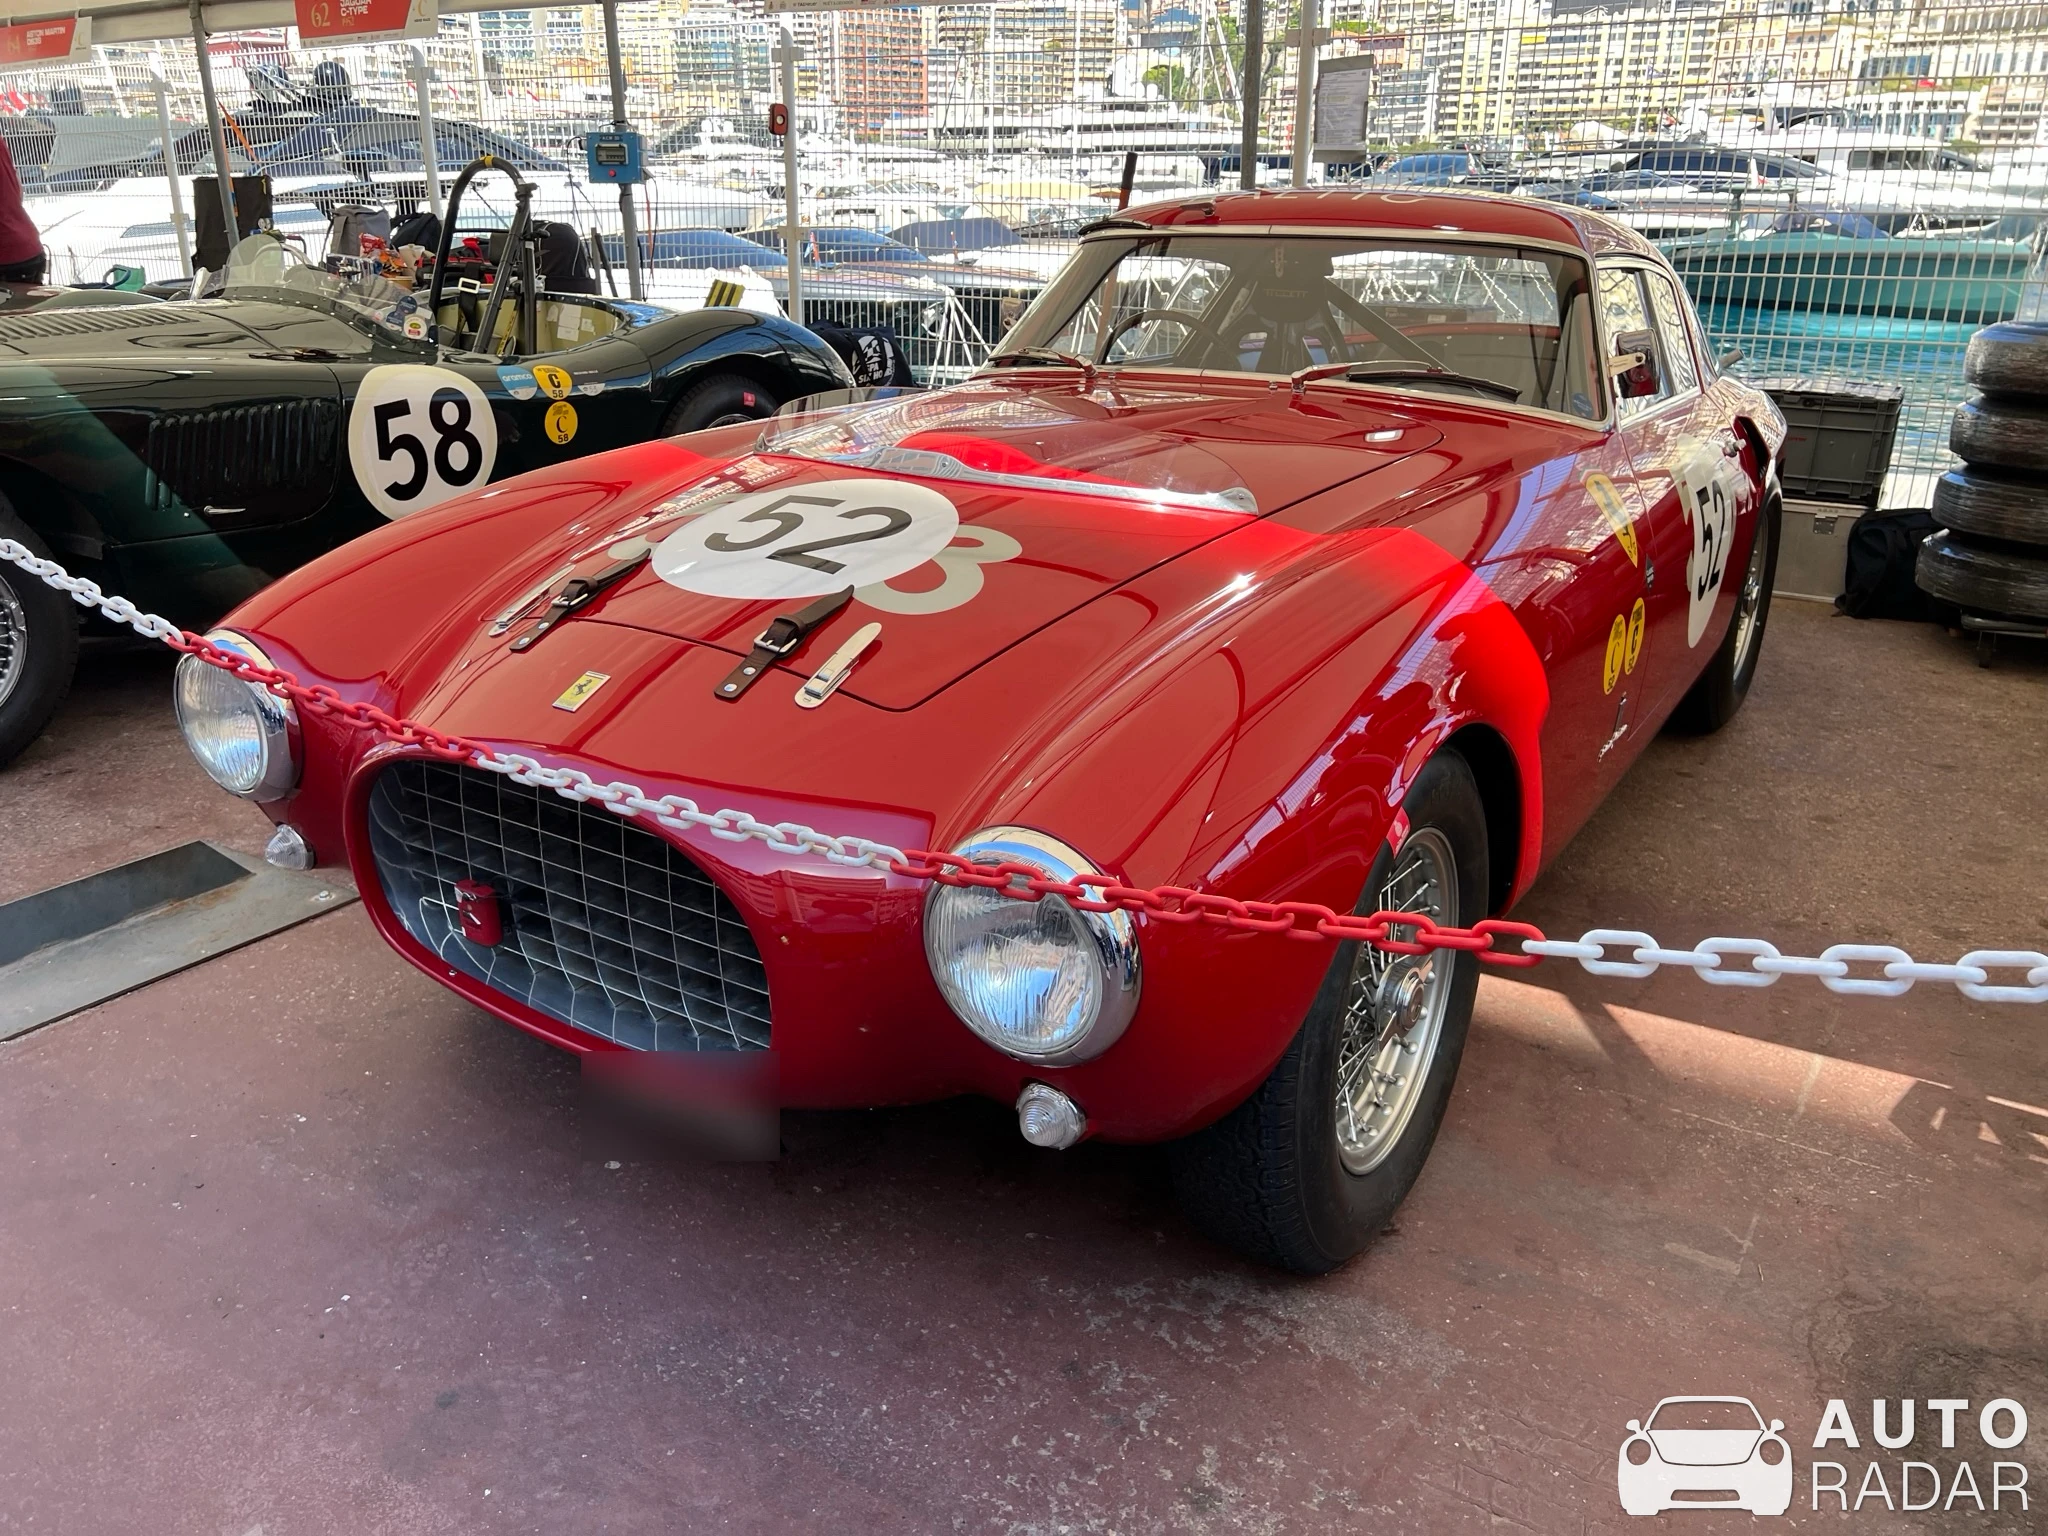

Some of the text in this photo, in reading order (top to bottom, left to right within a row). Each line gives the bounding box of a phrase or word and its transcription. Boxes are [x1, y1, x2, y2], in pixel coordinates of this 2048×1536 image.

[310, 2, 331, 28] 62
[340, 5, 369, 16] C-TYPE
[501, 373, 533, 382] aramco
[547, 373, 561, 389] C
[552, 389, 564, 398] 58
[556, 415, 568, 433] C
[373, 386, 483, 502] 58
[557, 433, 569, 443] 58
[704, 494, 913, 576] 52
[1696, 479, 1726, 602] 52
